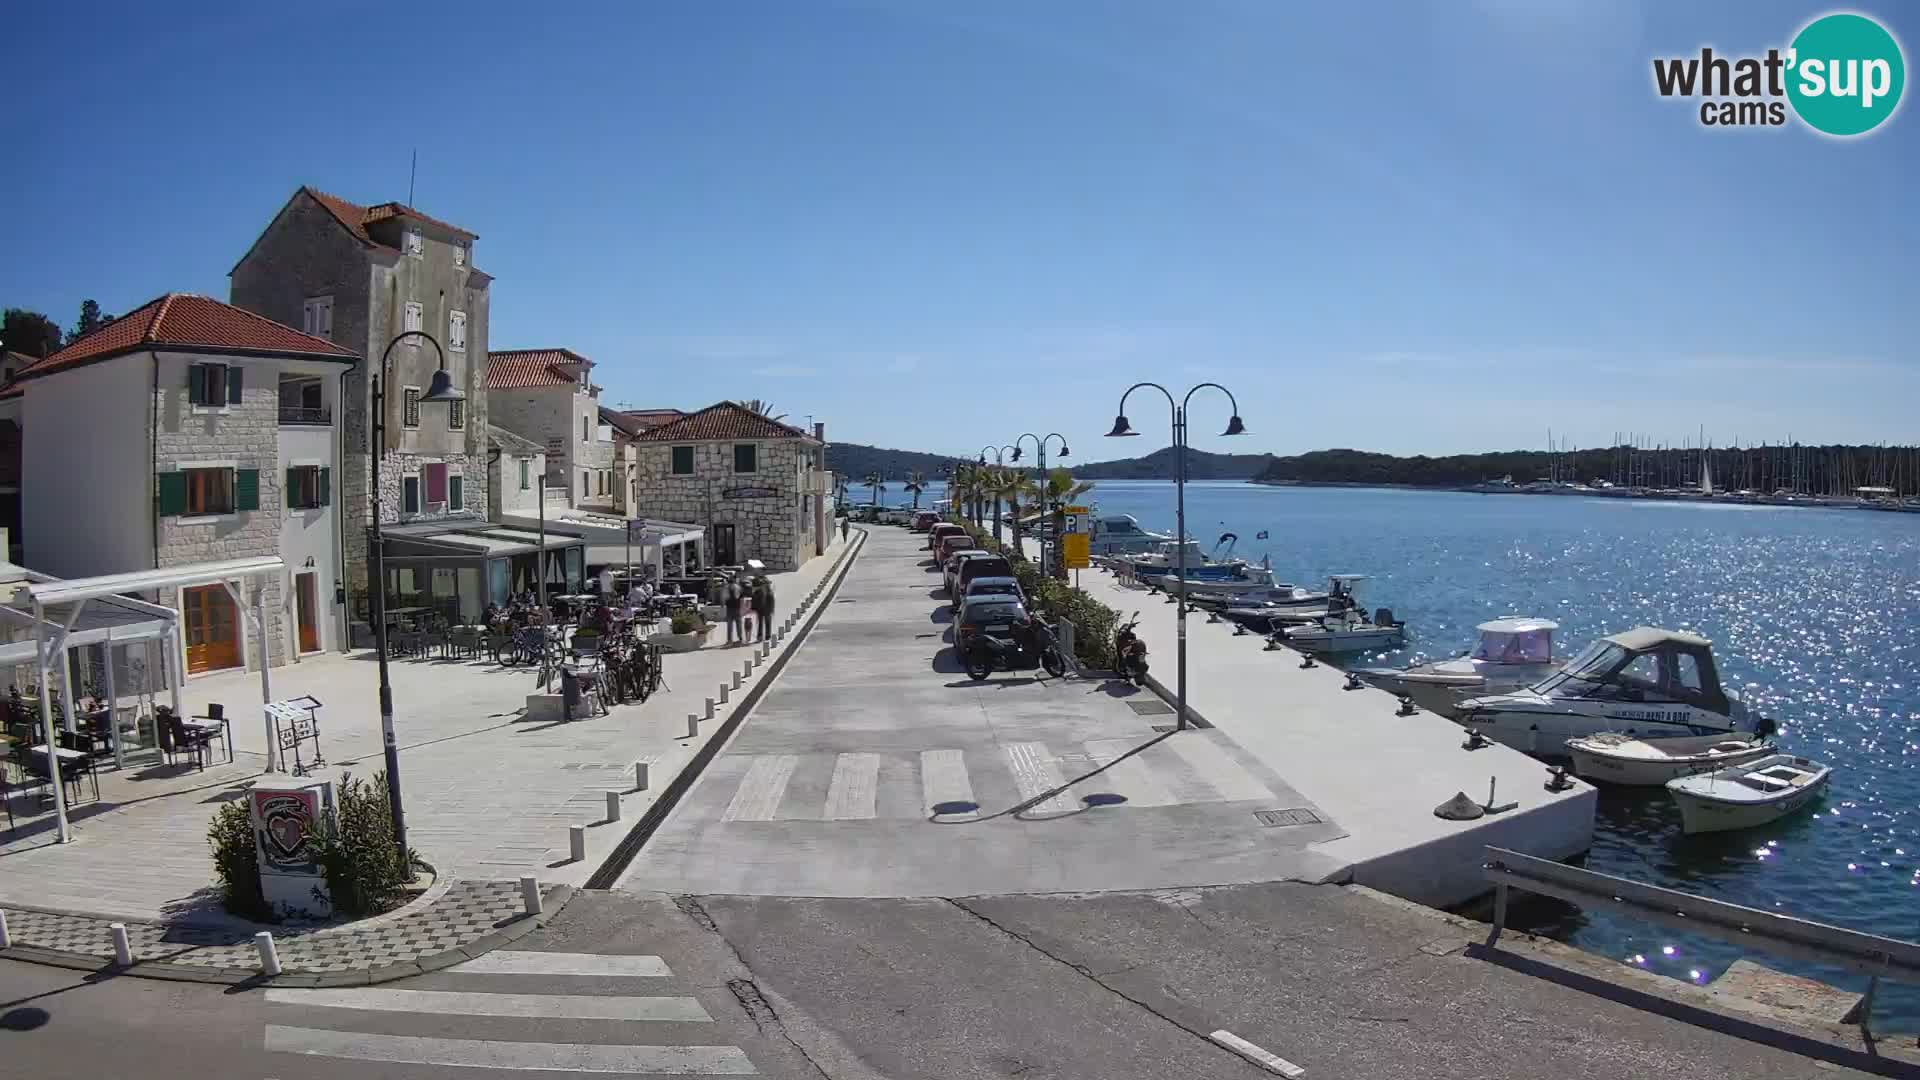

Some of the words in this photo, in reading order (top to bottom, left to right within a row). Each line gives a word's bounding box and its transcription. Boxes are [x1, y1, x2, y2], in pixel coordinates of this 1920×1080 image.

[1065, 515, 1076, 531] P
[1647, 711, 1664, 720] RENT
[1672, 711, 1690, 721] BOAT
